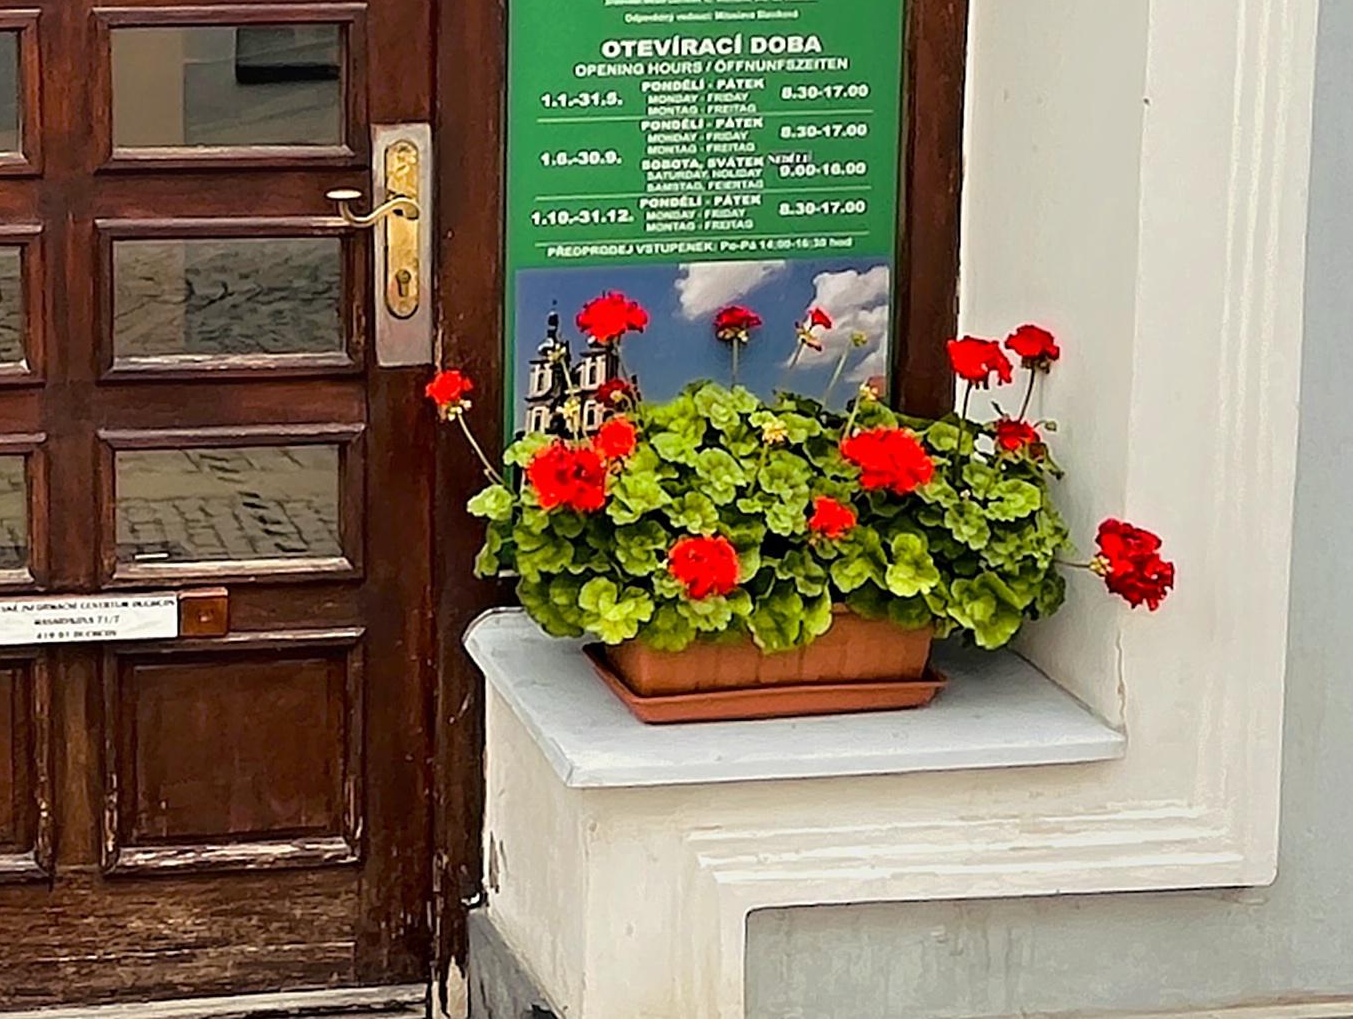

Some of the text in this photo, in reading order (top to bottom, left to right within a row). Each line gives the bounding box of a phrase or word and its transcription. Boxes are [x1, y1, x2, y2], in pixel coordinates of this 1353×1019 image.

[601, 33, 822, 59] OTEVÍRACÍ DOBA
[575, 62, 645, 78] OPENING
[648, 60, 703, 75] HOURS
